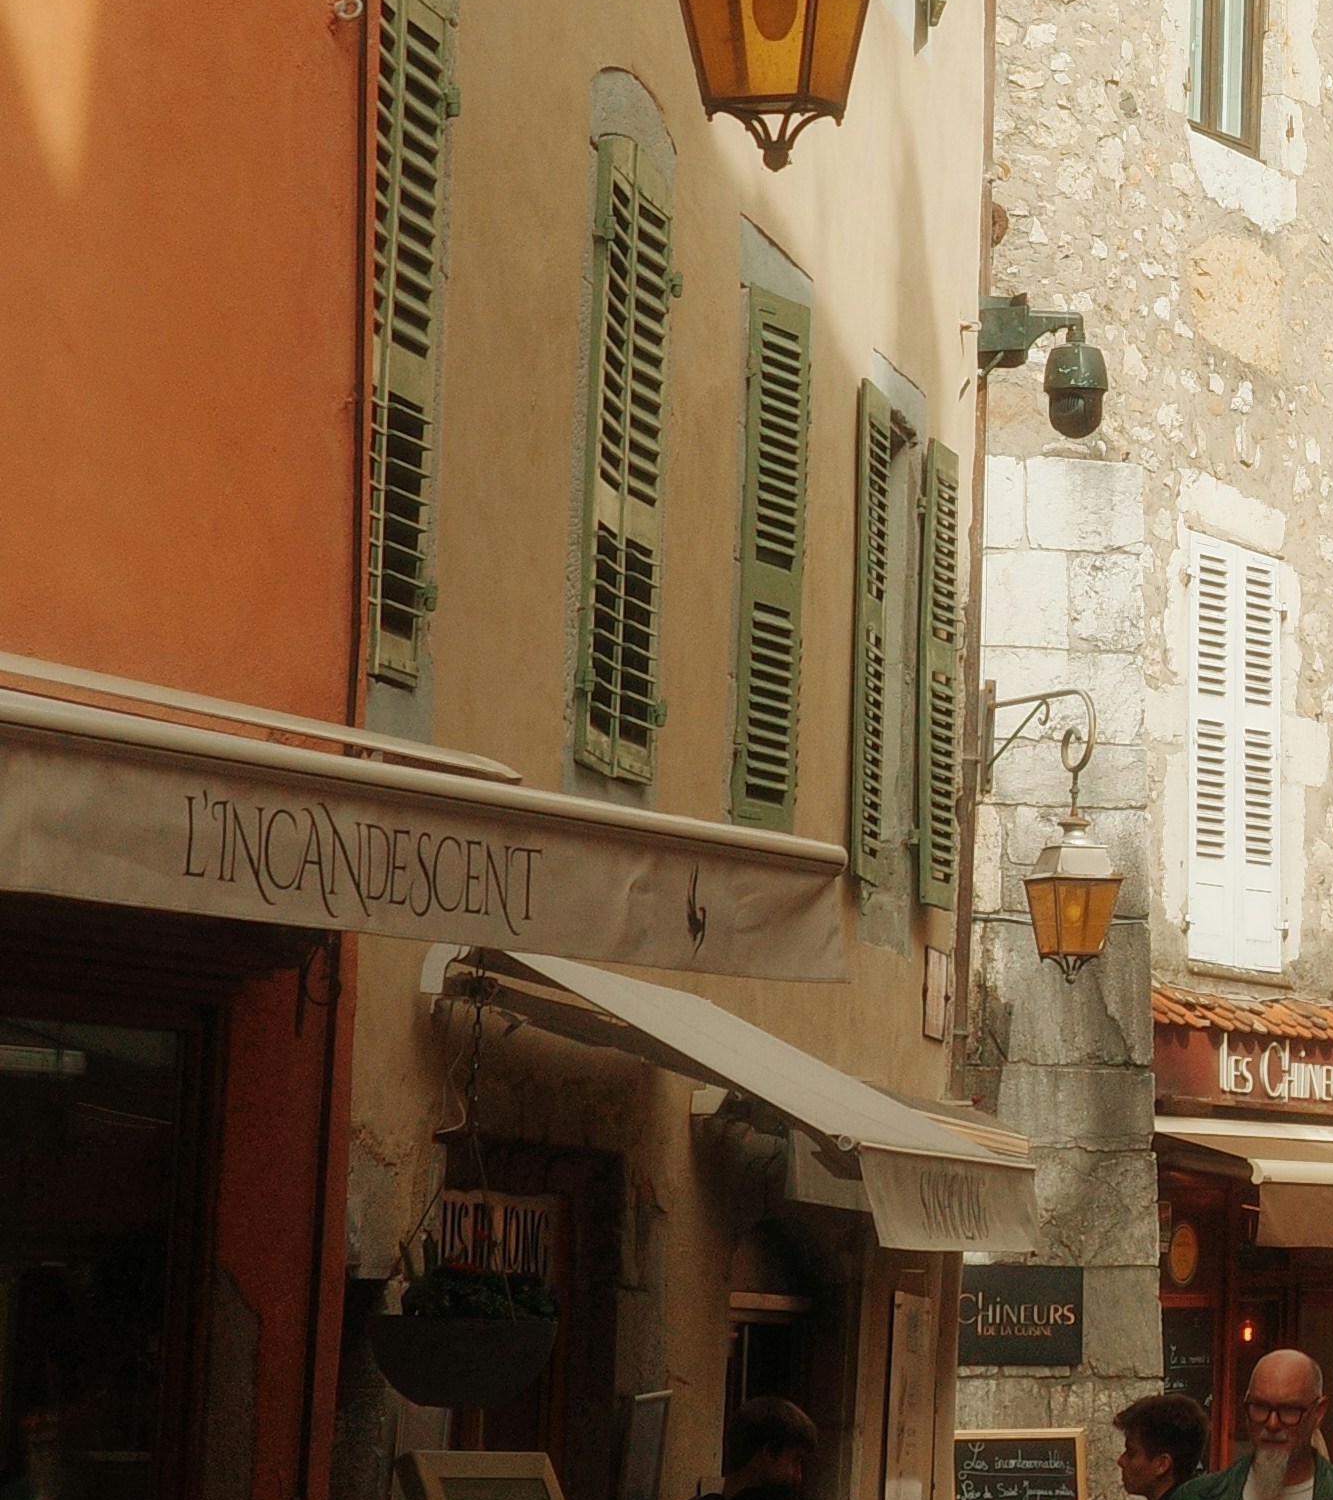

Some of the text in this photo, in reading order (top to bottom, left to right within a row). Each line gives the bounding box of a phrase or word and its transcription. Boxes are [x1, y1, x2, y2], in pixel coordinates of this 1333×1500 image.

[183, 789, 543, 937] L'INCANDESCENT
[984, 1325, 1053, 1337] DE LA CUISINE
[963, 1441, 989, 1471] Les
